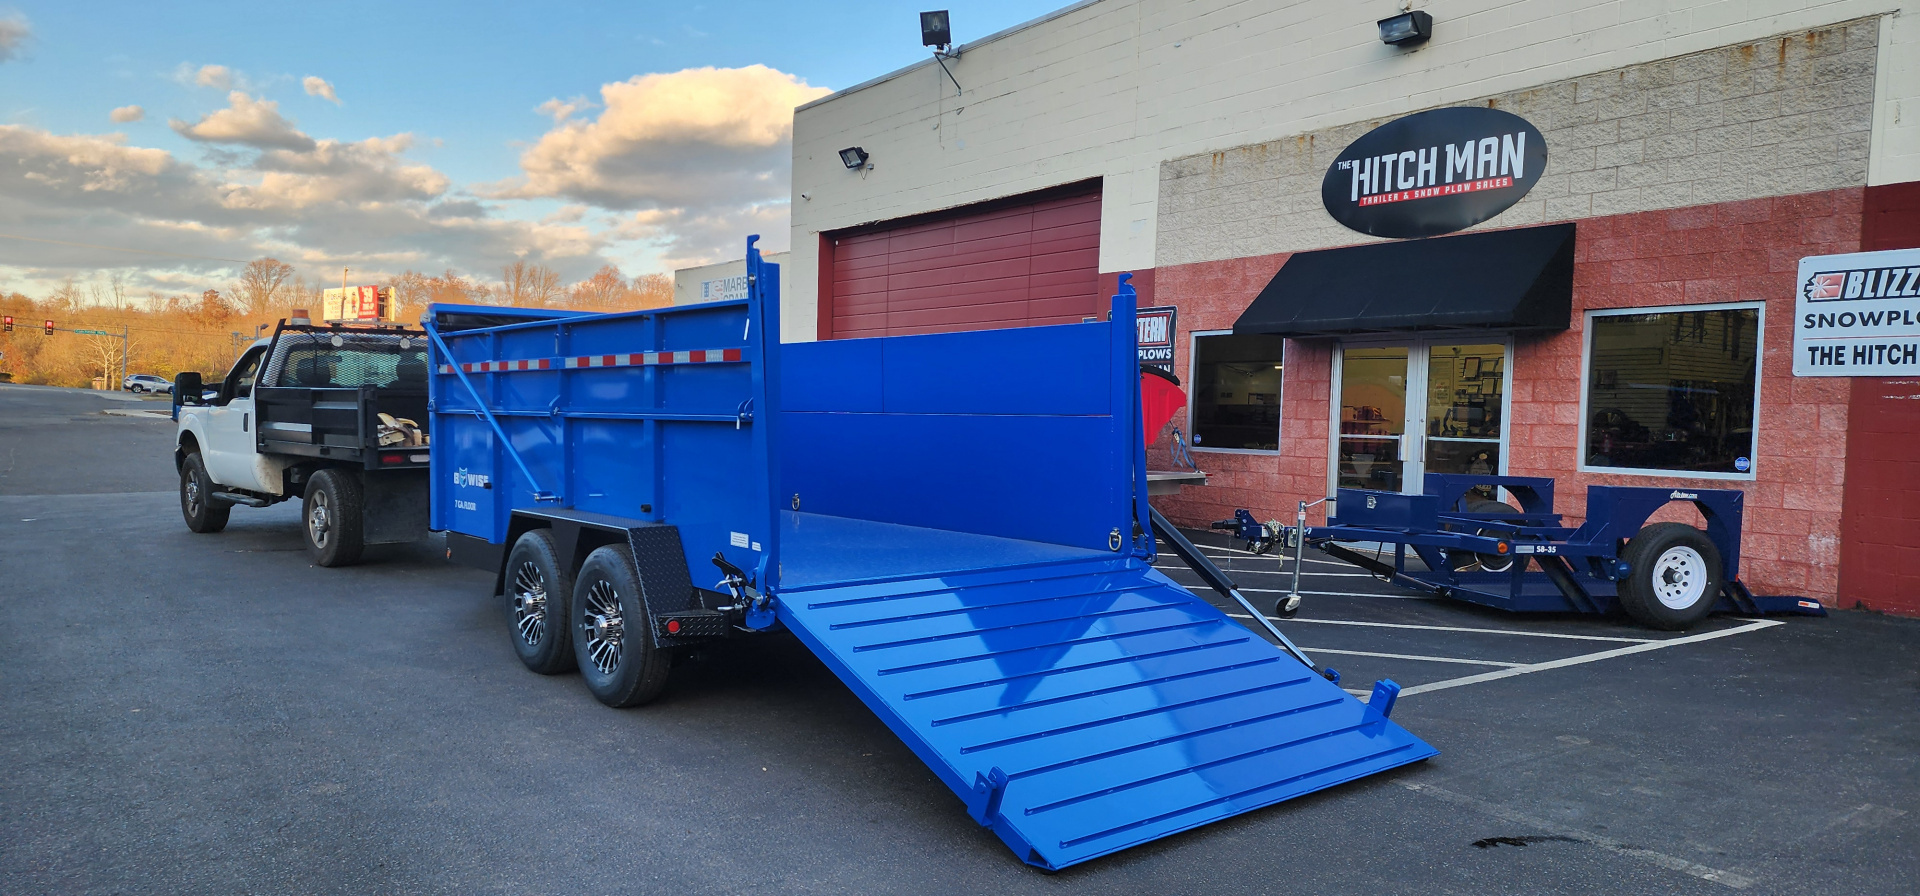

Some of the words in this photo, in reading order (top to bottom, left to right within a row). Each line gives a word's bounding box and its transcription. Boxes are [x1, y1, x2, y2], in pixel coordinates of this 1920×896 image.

[1338, 160, 1351, 170] THE
[1351, 147, 1438, 202] HITCH
[1445, 131, 1526, 183] MAN
[1362, 194, 1399, 206] TRAILER
[1403, 191, 1409, 200] &
[1414, 187, 1441, 199] SNOW
[1444, 183, 1471, 194] PLOW
[1476, 178, 1508, 190] SALES
[1136, 316, 1167, 342] TERN
[1804, 310, 1920, 329] SNOWPL
[1807, 345, 1846, 366] THE
[1852, 344, 1918, 365] HITCH
